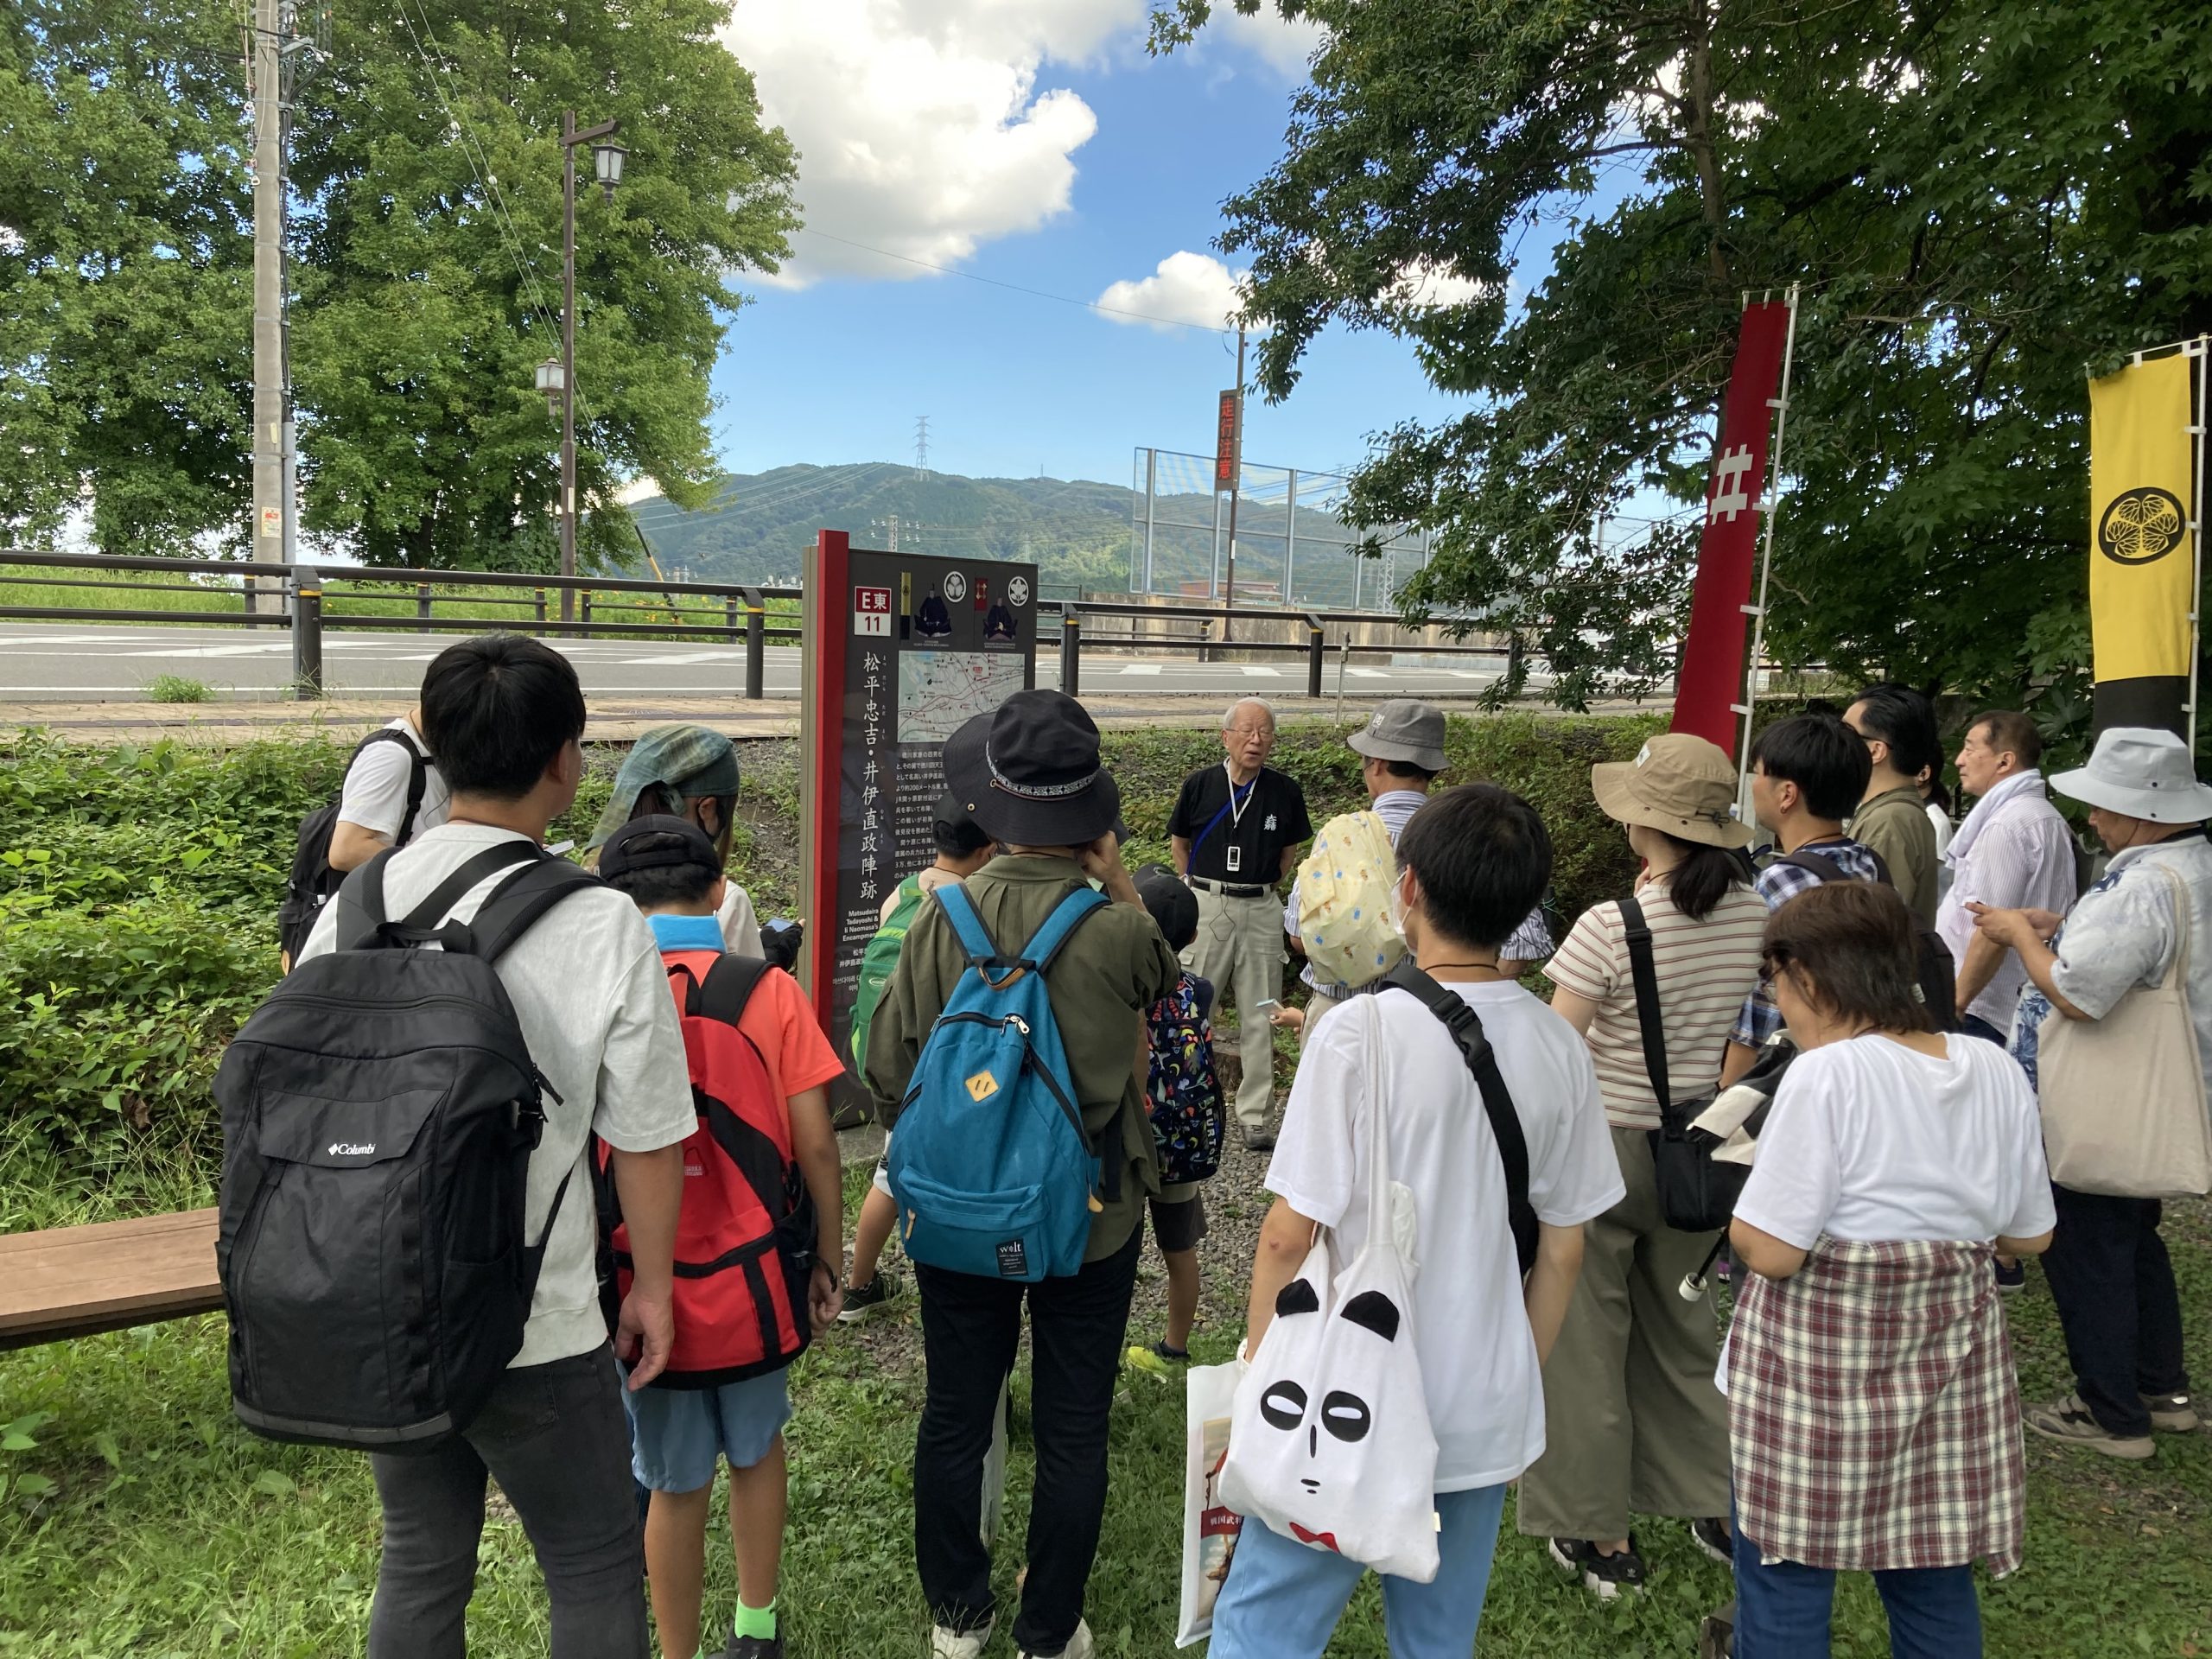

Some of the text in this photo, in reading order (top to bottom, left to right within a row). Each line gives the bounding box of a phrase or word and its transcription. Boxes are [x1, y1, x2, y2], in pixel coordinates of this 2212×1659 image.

[1219, 397, 1234, 479] 走行注意
[861, 592, 887, 610] E東
[864, 615, 880, 632] 11
[860, 652, 881, 899] 松平忠吉・井伊直政陣跡
[846, 917, 873, 925] Tadayoshi
[849, 908, 879, 917] Matsudaira
[842, 933, 876, 942] Encampmen
[1205, 1108, 1217, 1165] BURTON
[337, 1143, 376, 1155] Columbi
